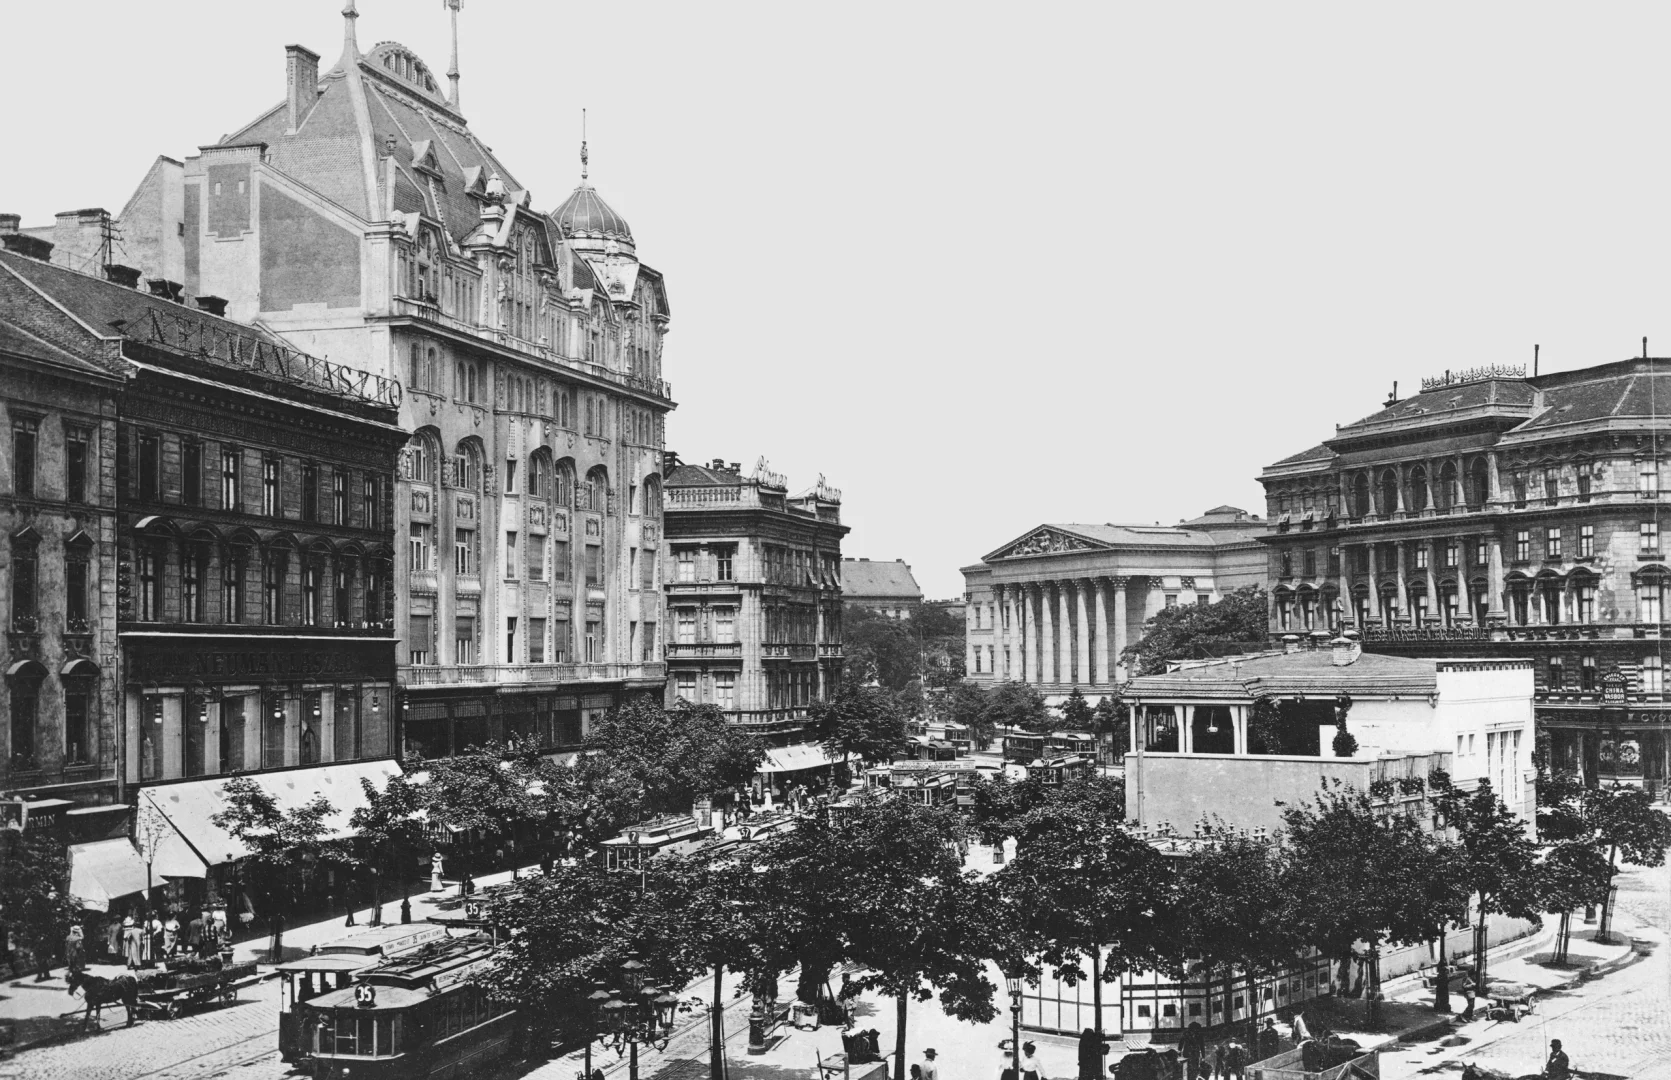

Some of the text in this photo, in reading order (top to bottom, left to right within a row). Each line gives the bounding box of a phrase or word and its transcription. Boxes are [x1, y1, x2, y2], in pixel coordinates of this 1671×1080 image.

[150, 307, 290, 378] NEUMAN
[194, 651, 285, 676] NEUMAN
[27, 813, 55, 829] RMIN
[631, 831, 636, 840] 7
[467, 902, 478, 915] 35
[358, 986, 372, 1003] 35
